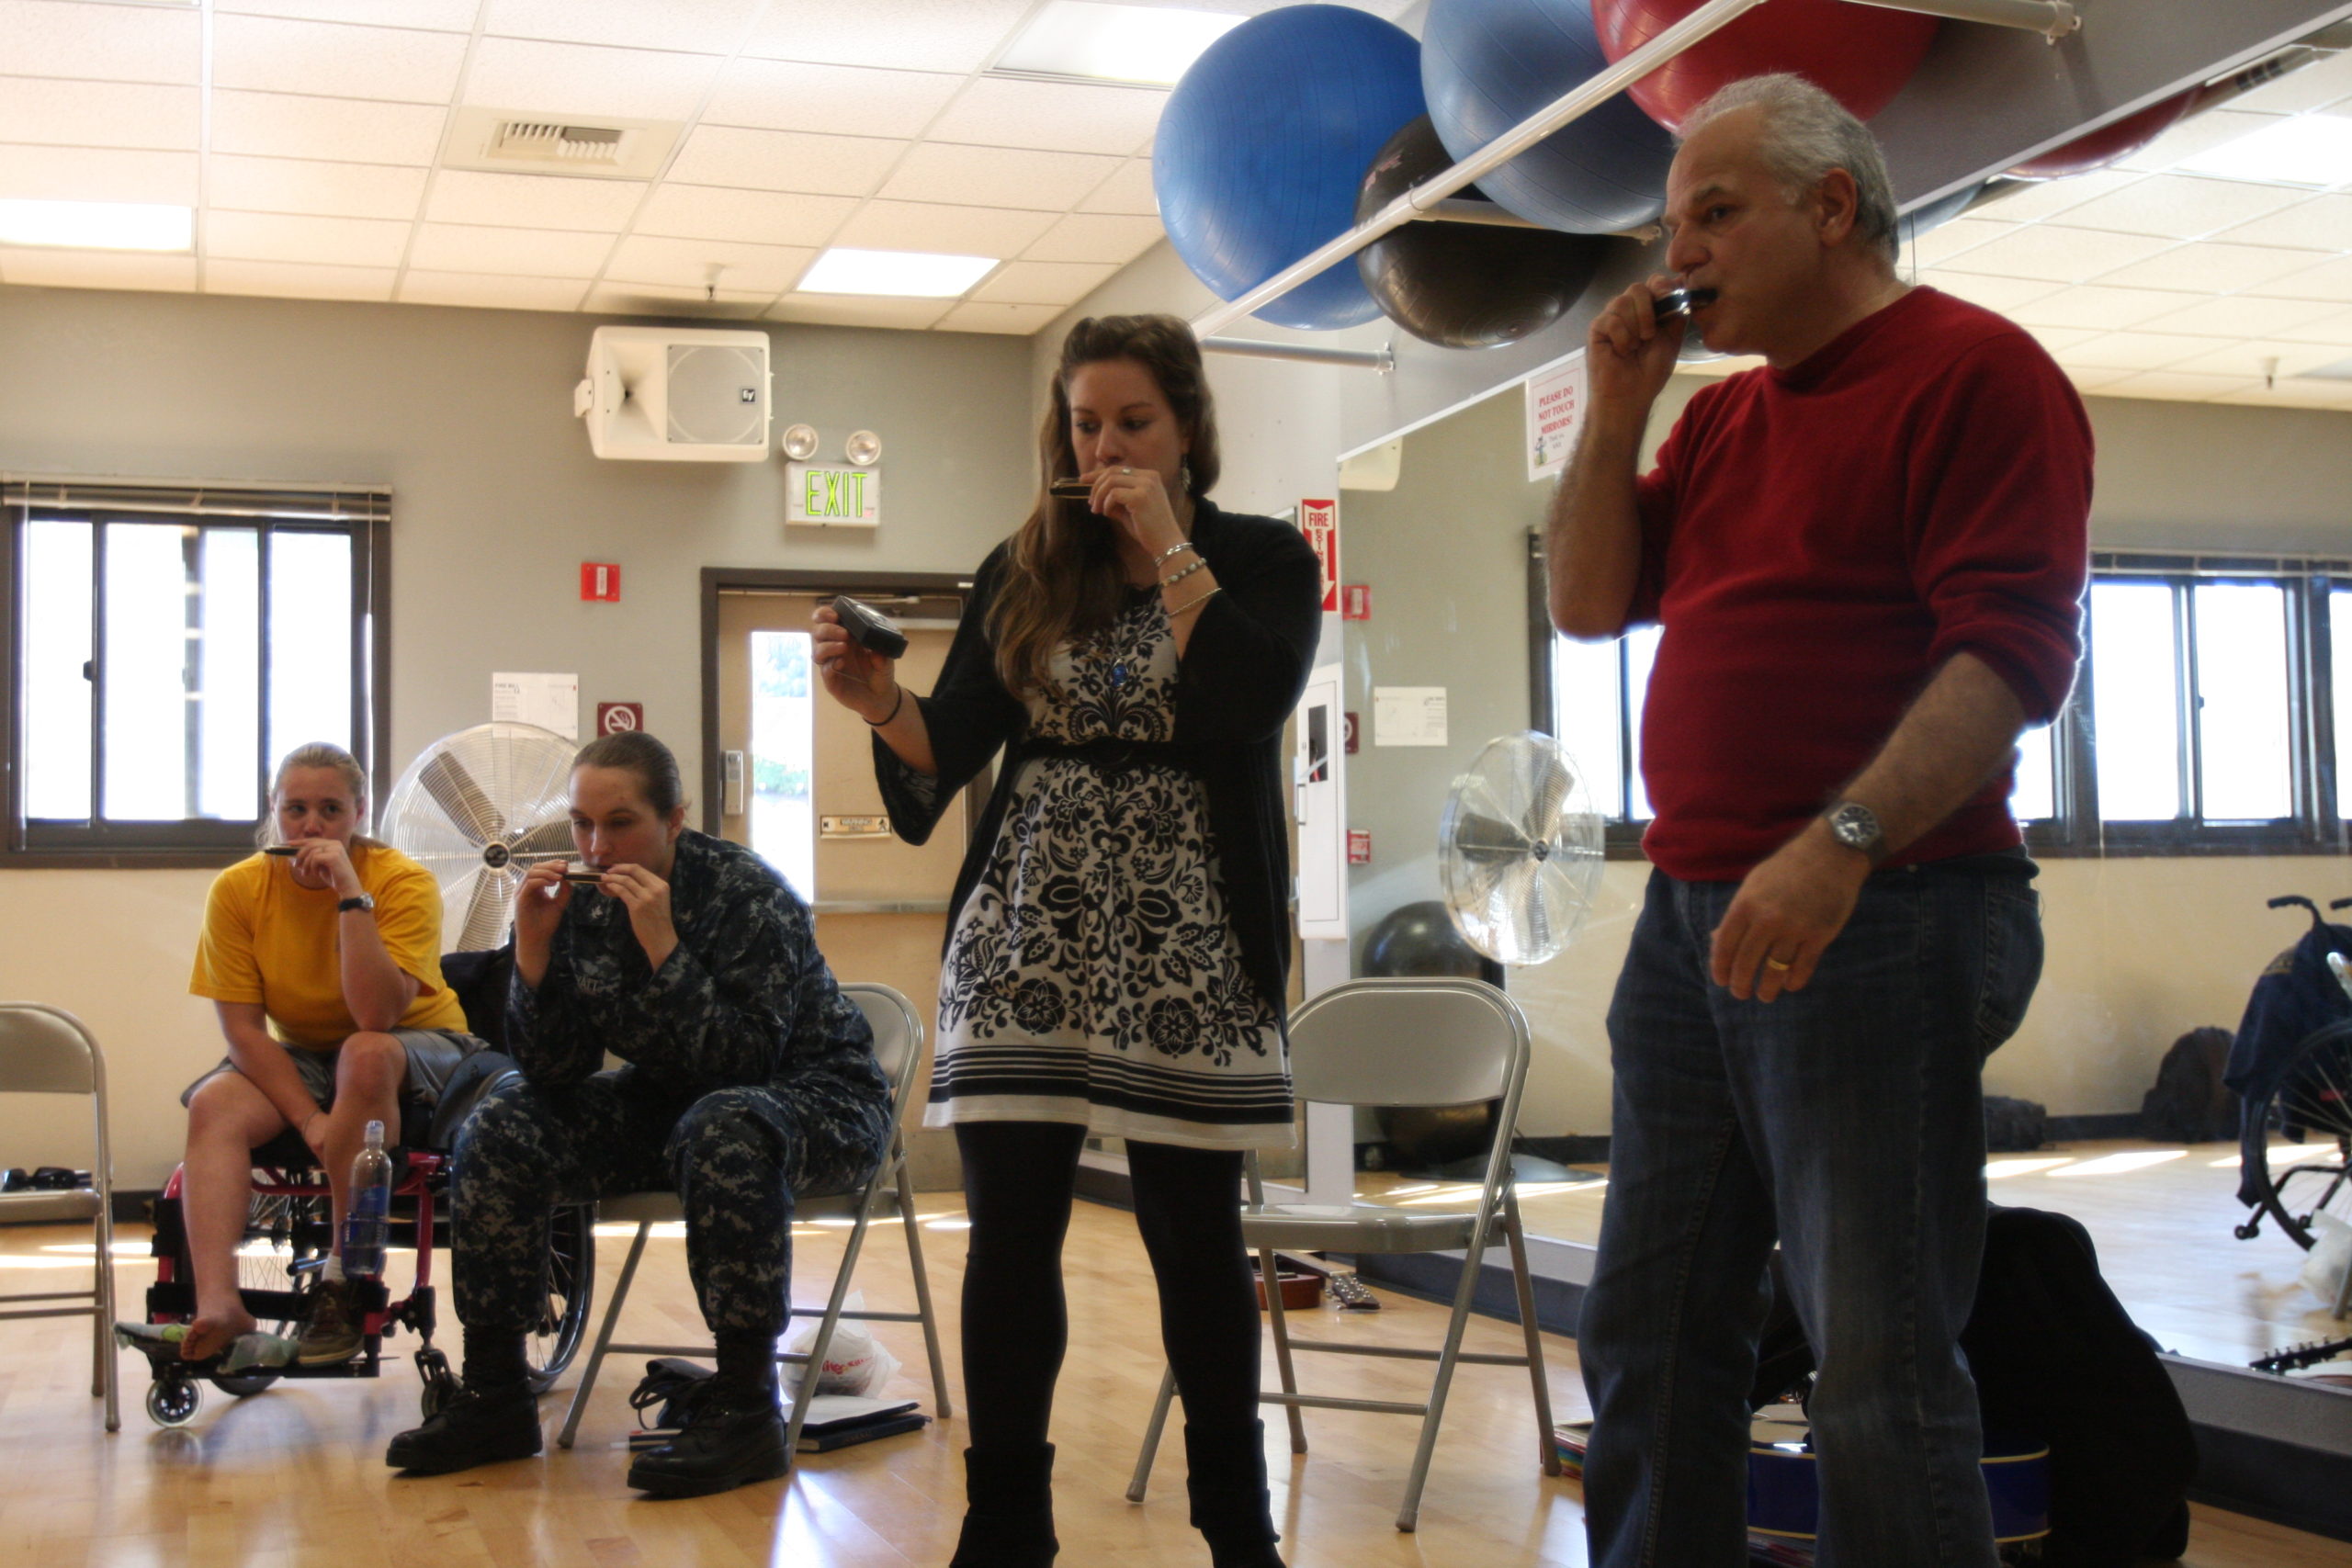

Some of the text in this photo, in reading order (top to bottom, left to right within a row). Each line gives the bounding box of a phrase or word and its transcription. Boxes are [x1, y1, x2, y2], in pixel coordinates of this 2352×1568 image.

[1539, 385, 1574, 407] PLEASE DO
[1538, 400, 1575, 421] NOT TOUCH
[806, 470, 868, 517] EXIT
[1308, 513, 1329, 526] FIRE
